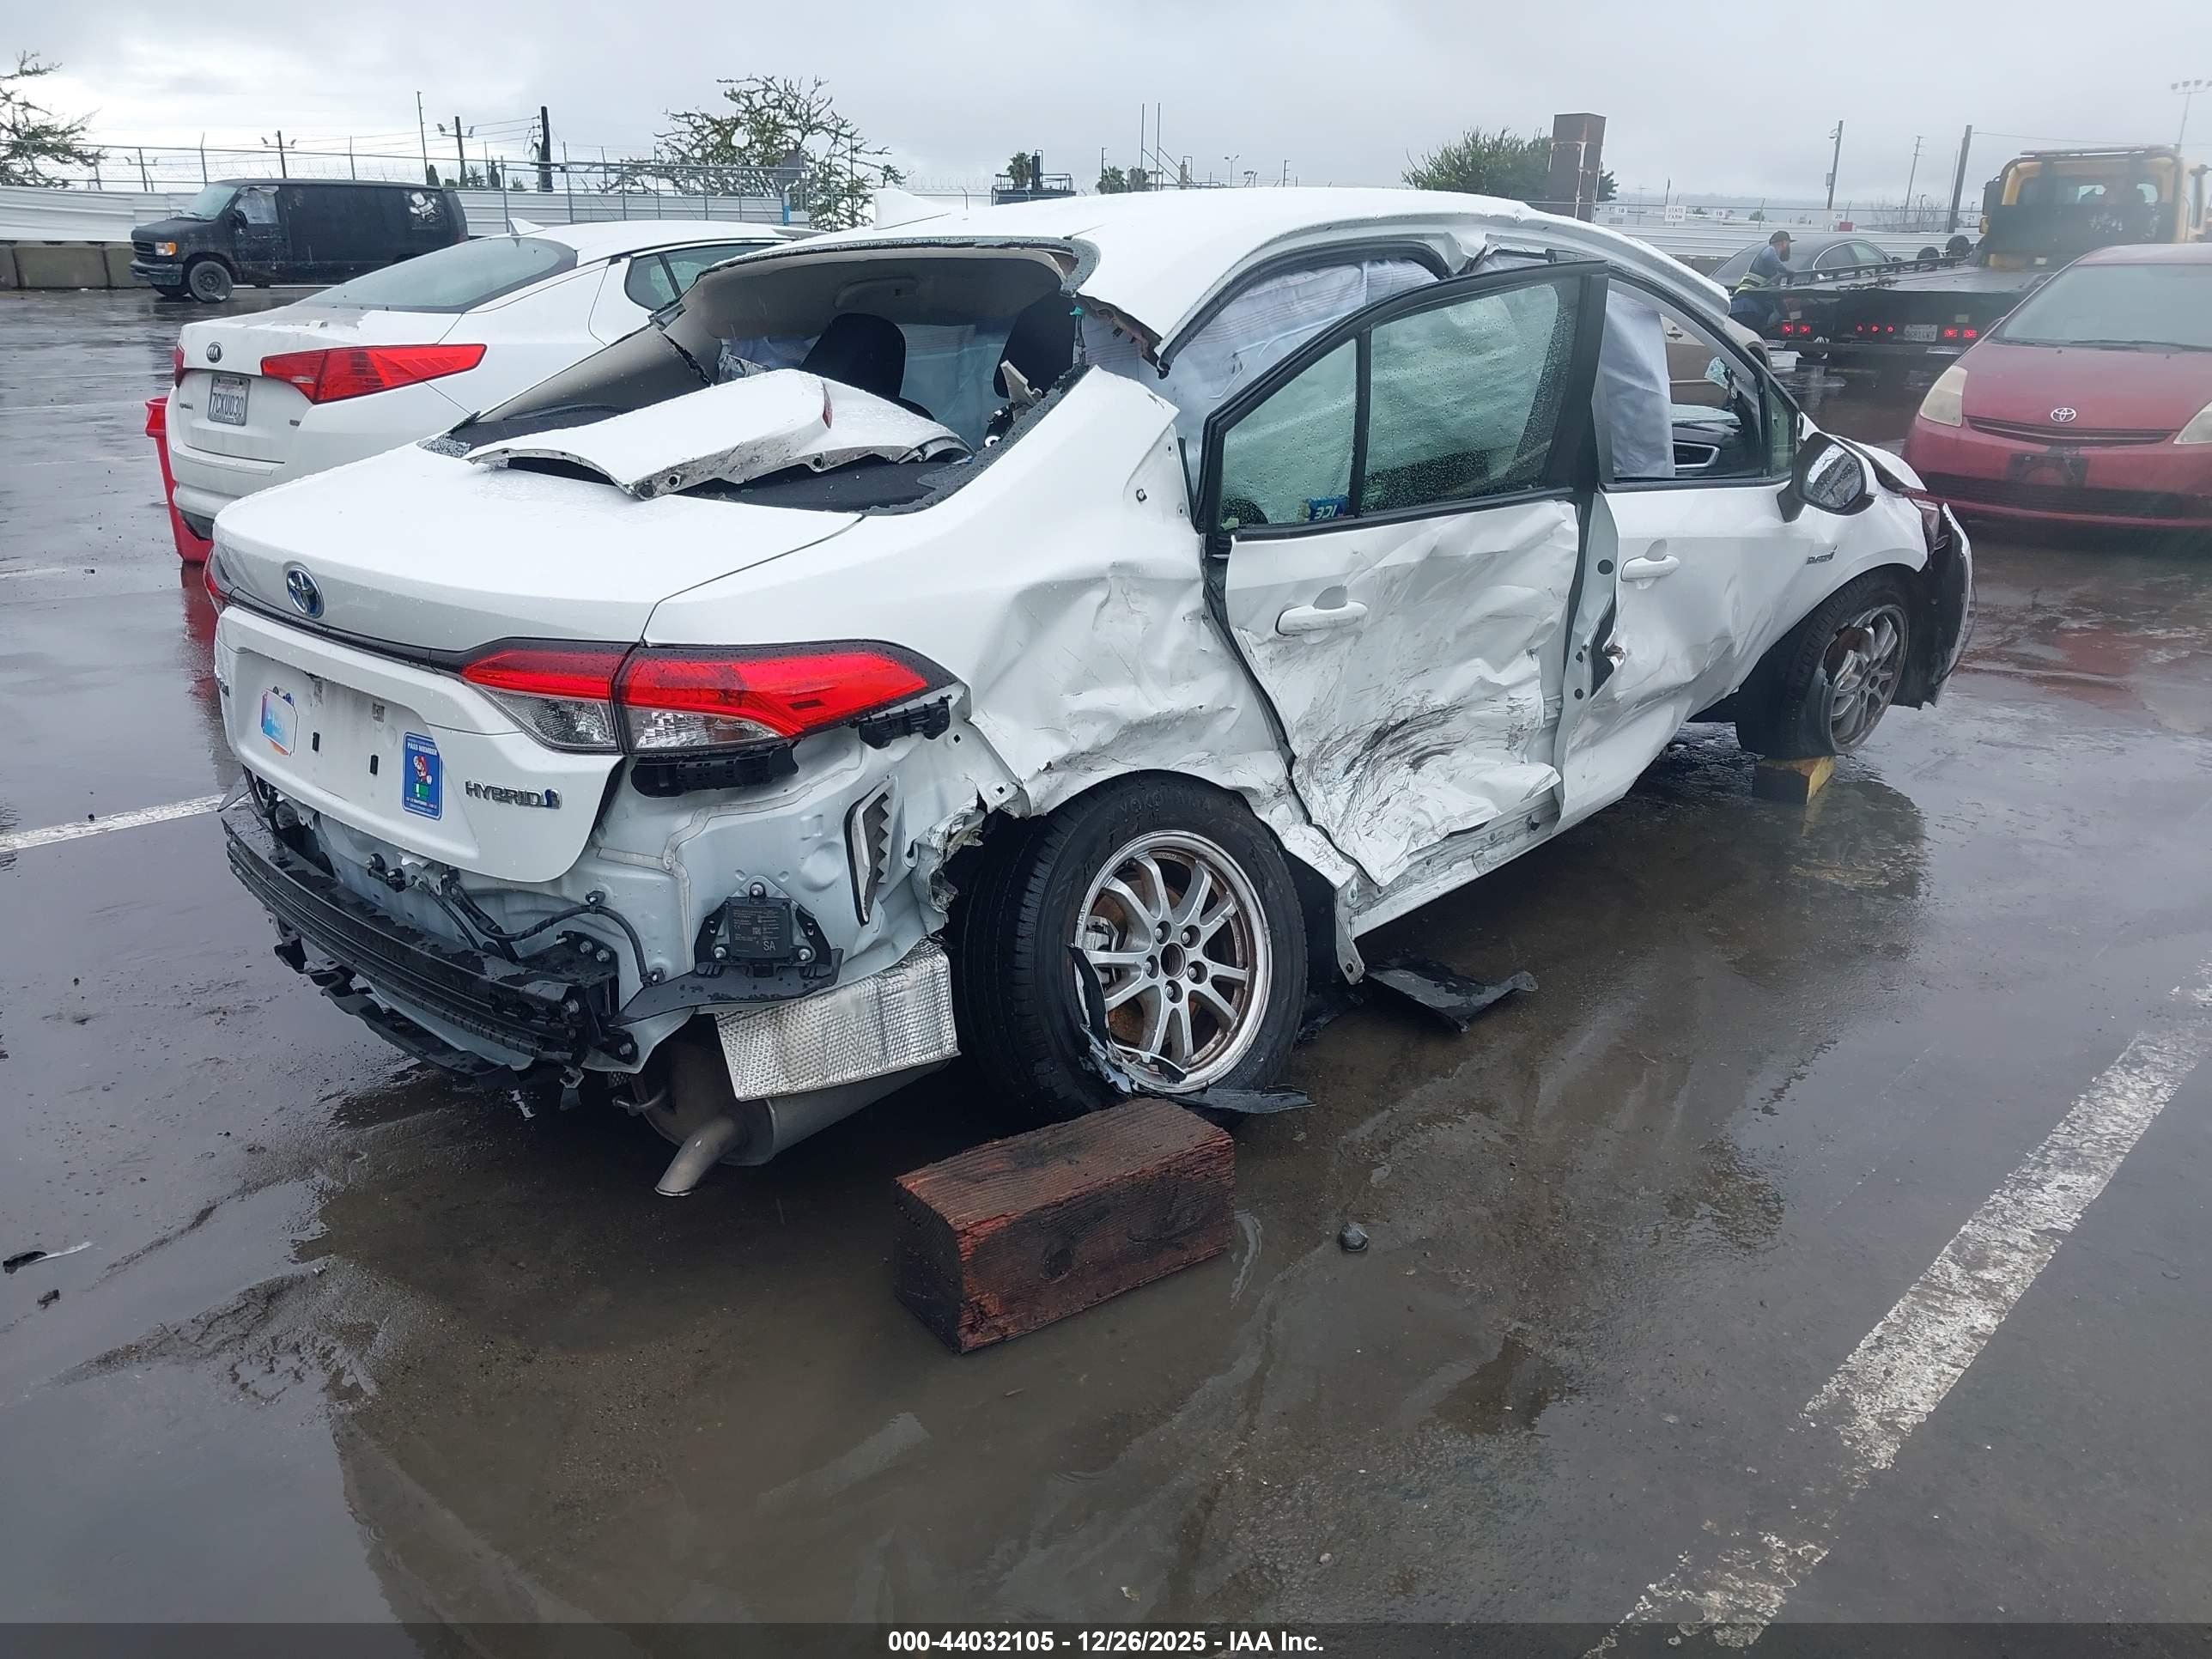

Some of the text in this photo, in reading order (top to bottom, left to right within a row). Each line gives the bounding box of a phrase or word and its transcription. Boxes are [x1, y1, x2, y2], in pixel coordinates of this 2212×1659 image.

[212, 392, 244, 417] 7CKU030
[407, 741, 418, 751] PASS
[465, 781, 543, 806] HYBRID
[763, 941, 776, 951] SA
